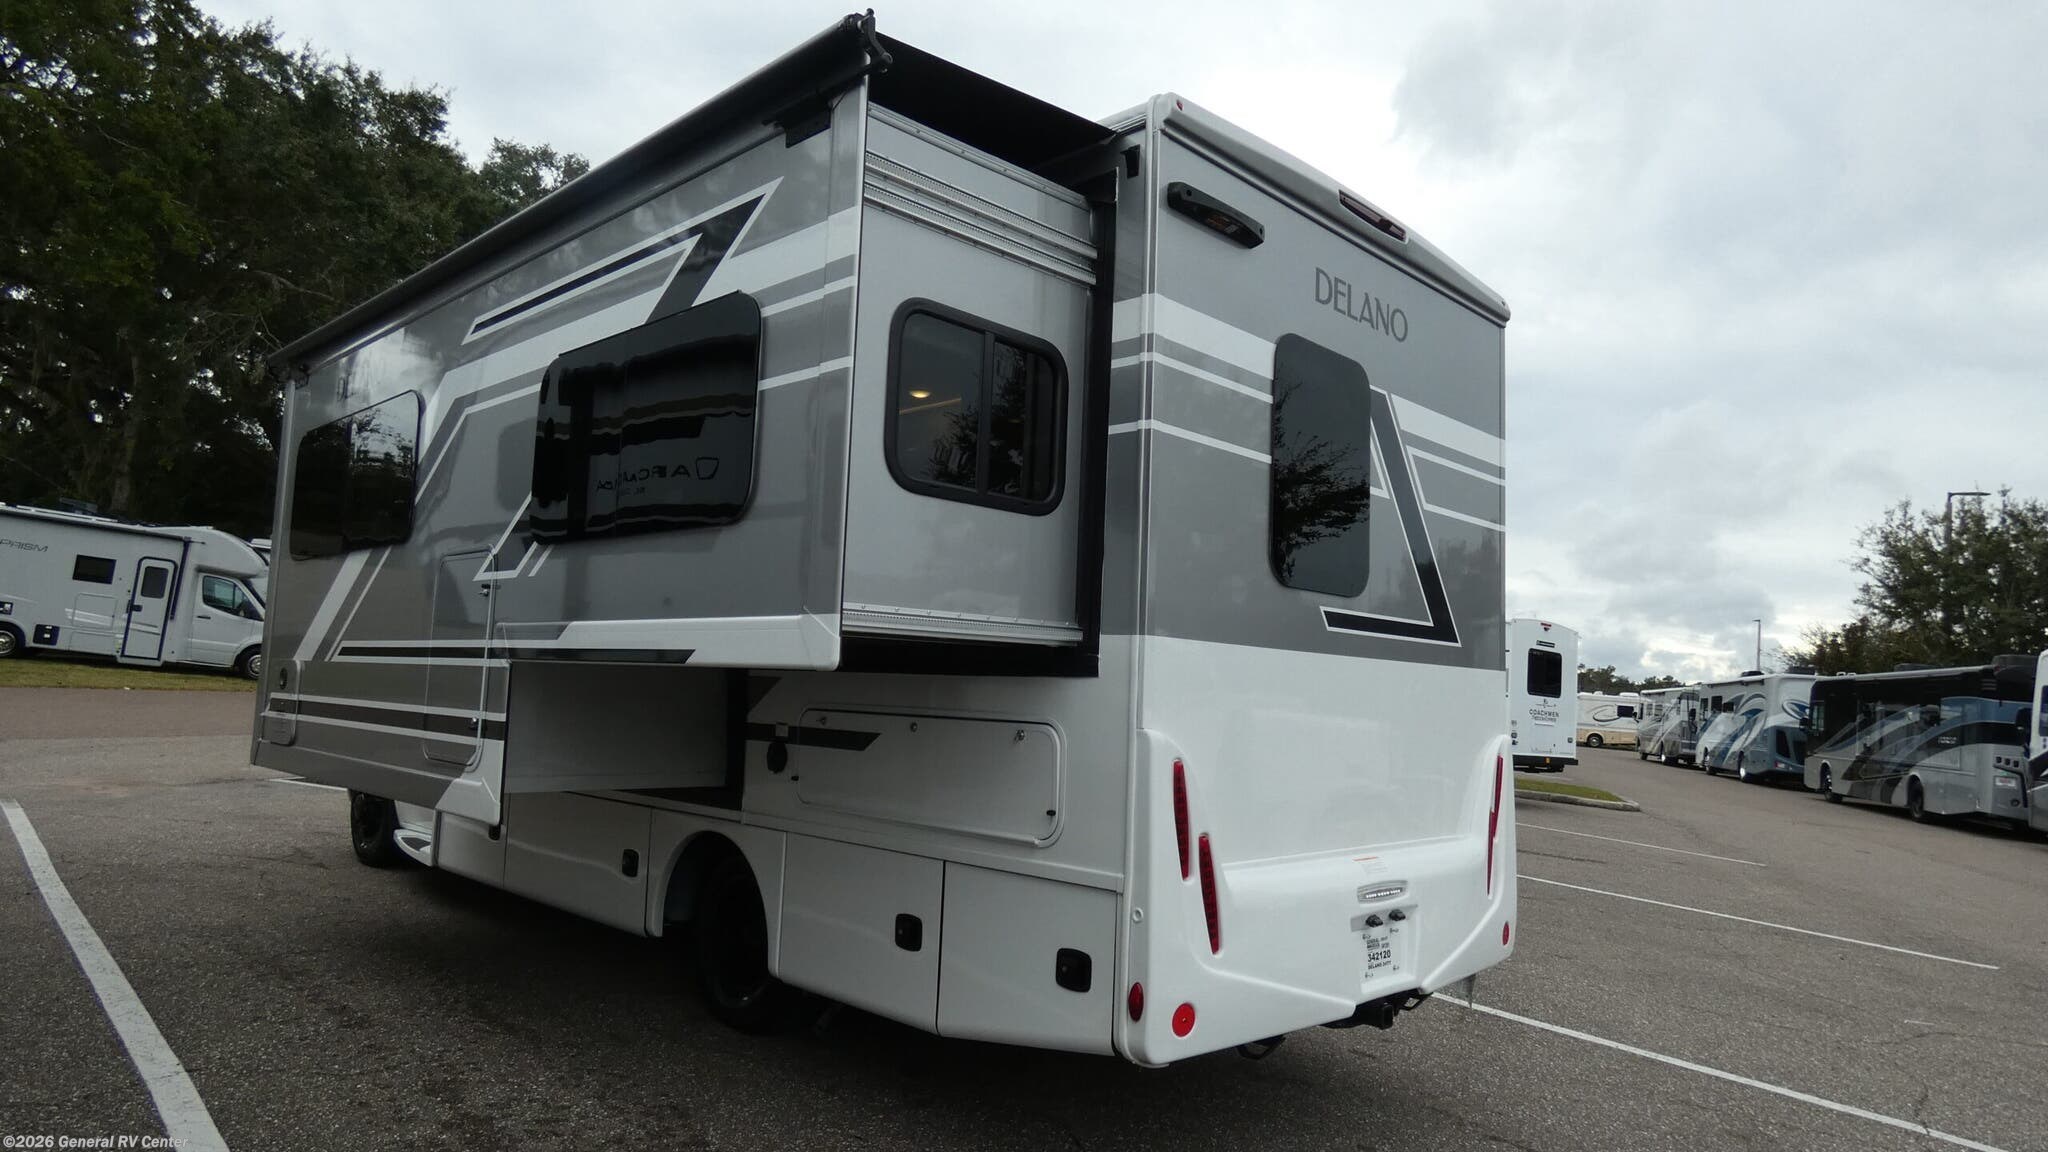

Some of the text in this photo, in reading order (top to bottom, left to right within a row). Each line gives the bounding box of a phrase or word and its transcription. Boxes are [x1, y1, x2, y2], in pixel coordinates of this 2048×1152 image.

[1315, 267, 1408, 342] DELANO
[1529, 709, 1559, 717] COACHMEN
[1368, 949, 1391, 962] 342120
